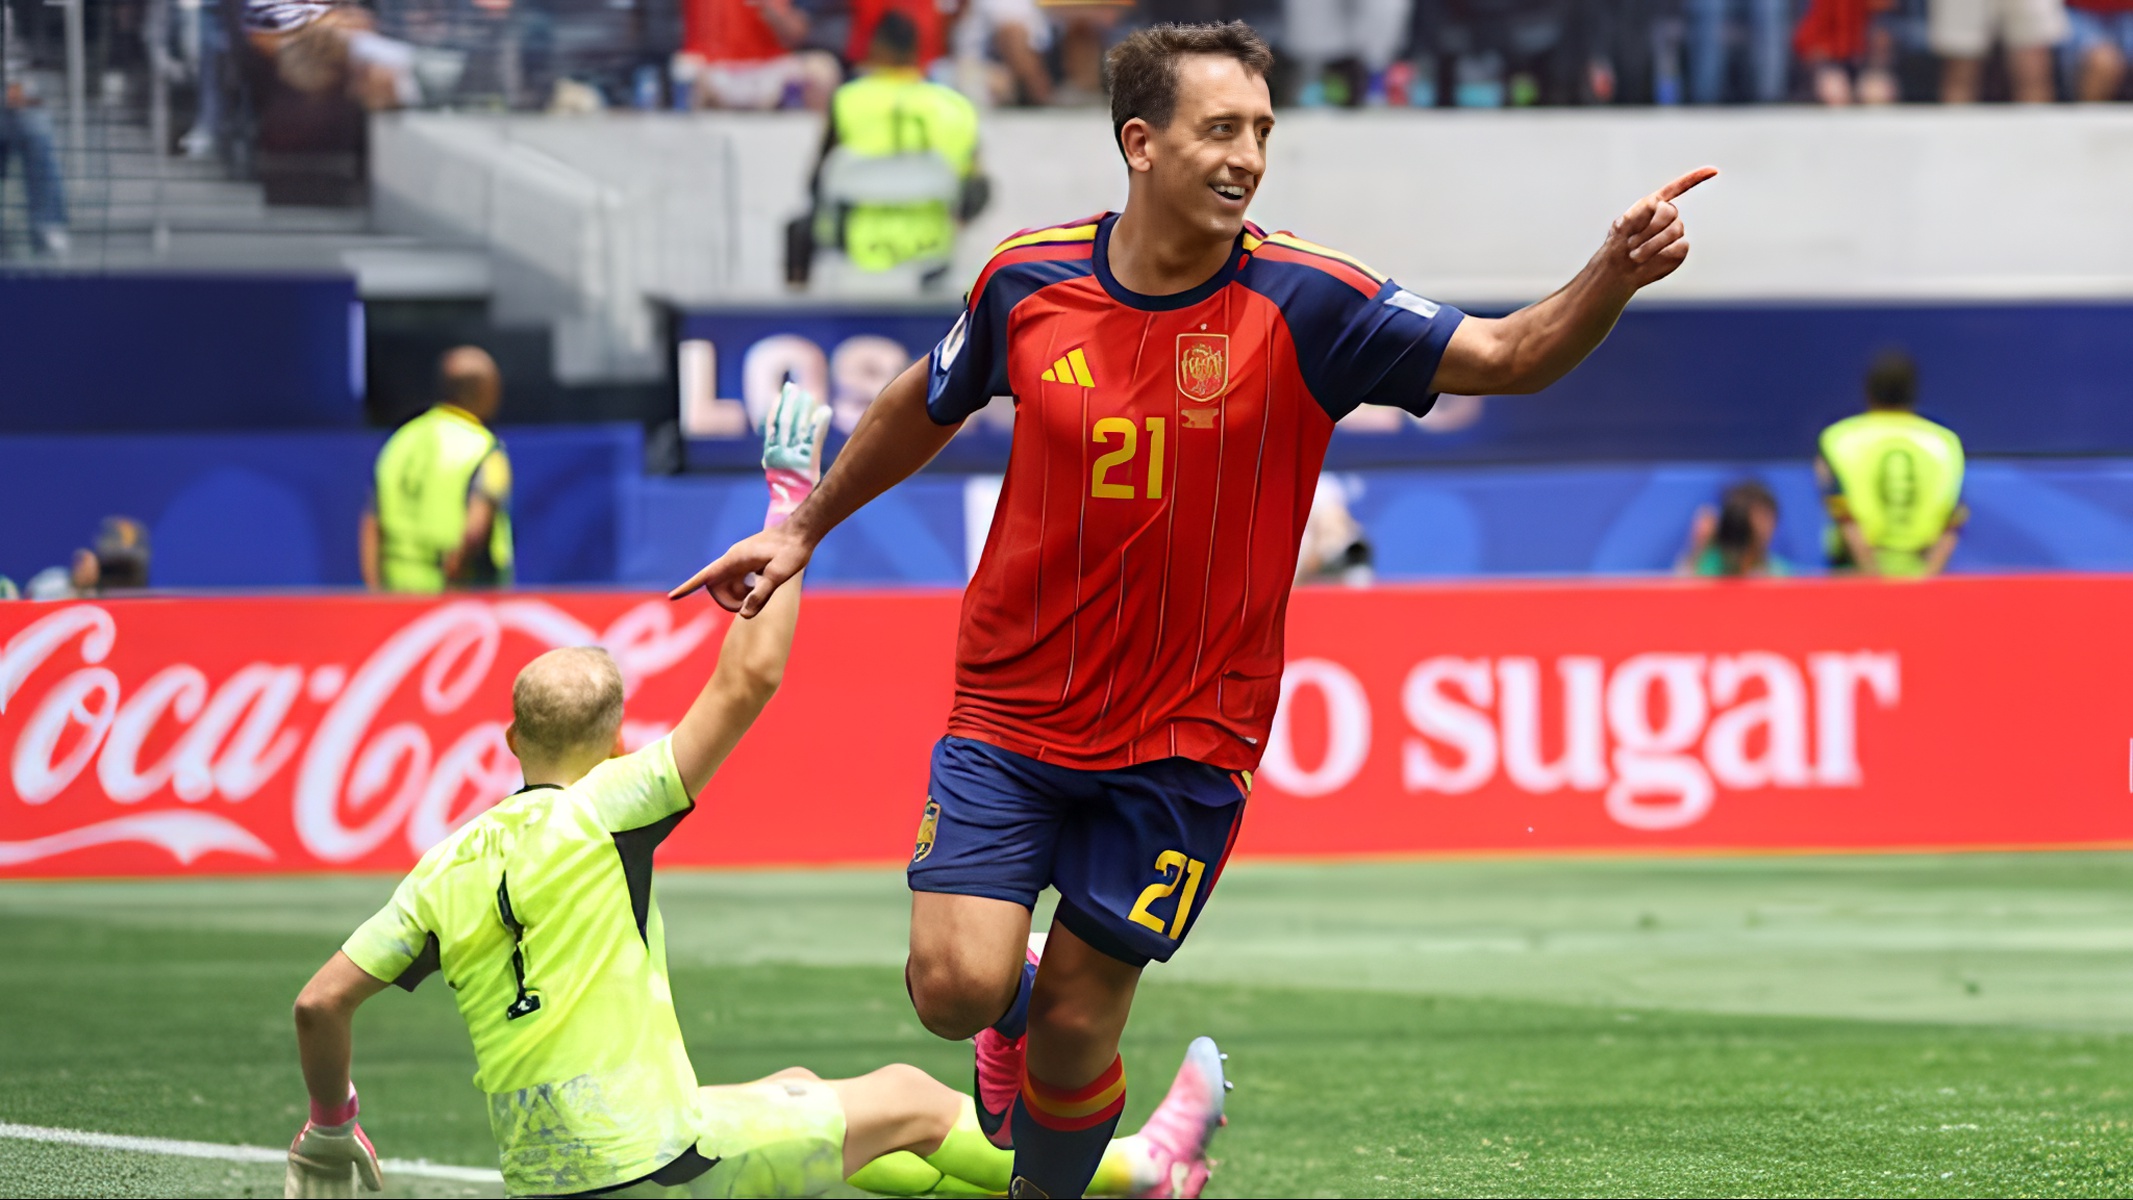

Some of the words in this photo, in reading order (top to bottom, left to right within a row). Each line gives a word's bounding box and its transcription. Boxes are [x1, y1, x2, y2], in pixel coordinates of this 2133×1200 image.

[1091, 416, 1166, 499] 21
[1403, 650, 1901, 830] sugar
[1127, 849, 1206, 941] 21
